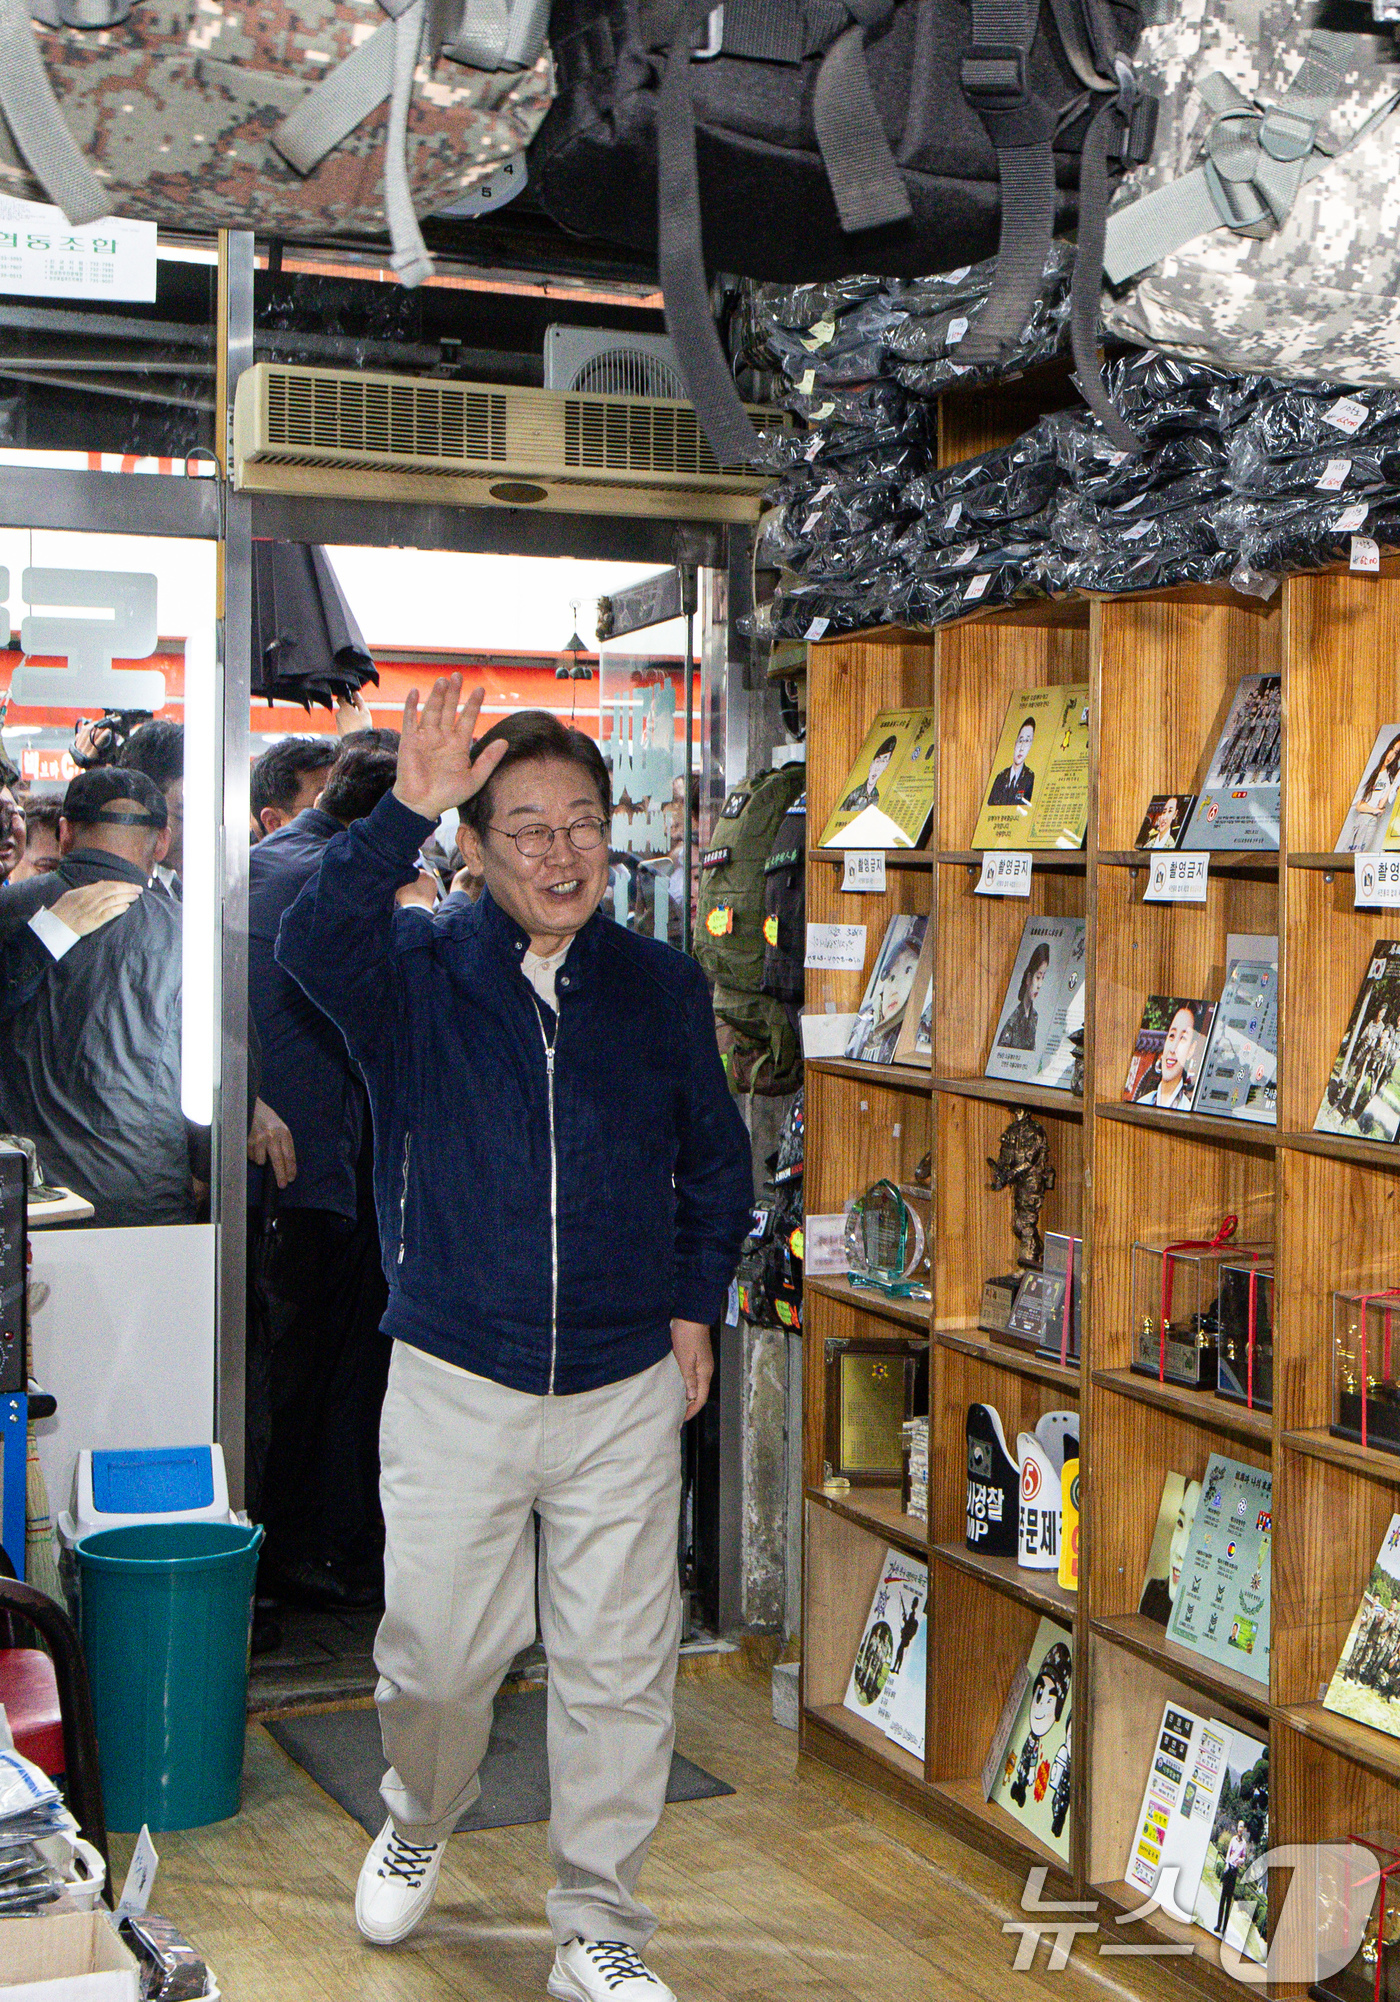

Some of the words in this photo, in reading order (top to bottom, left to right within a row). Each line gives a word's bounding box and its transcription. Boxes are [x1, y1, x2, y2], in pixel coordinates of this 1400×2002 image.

[504, 164, 513, 175] 4
[482, 187, 491, 198] 5
[858, 857, 882, 873] 촬영금지
[998, 859, 1029, 876] 촬영금지
[1169, 861, 1205, 879] 촬영금지
